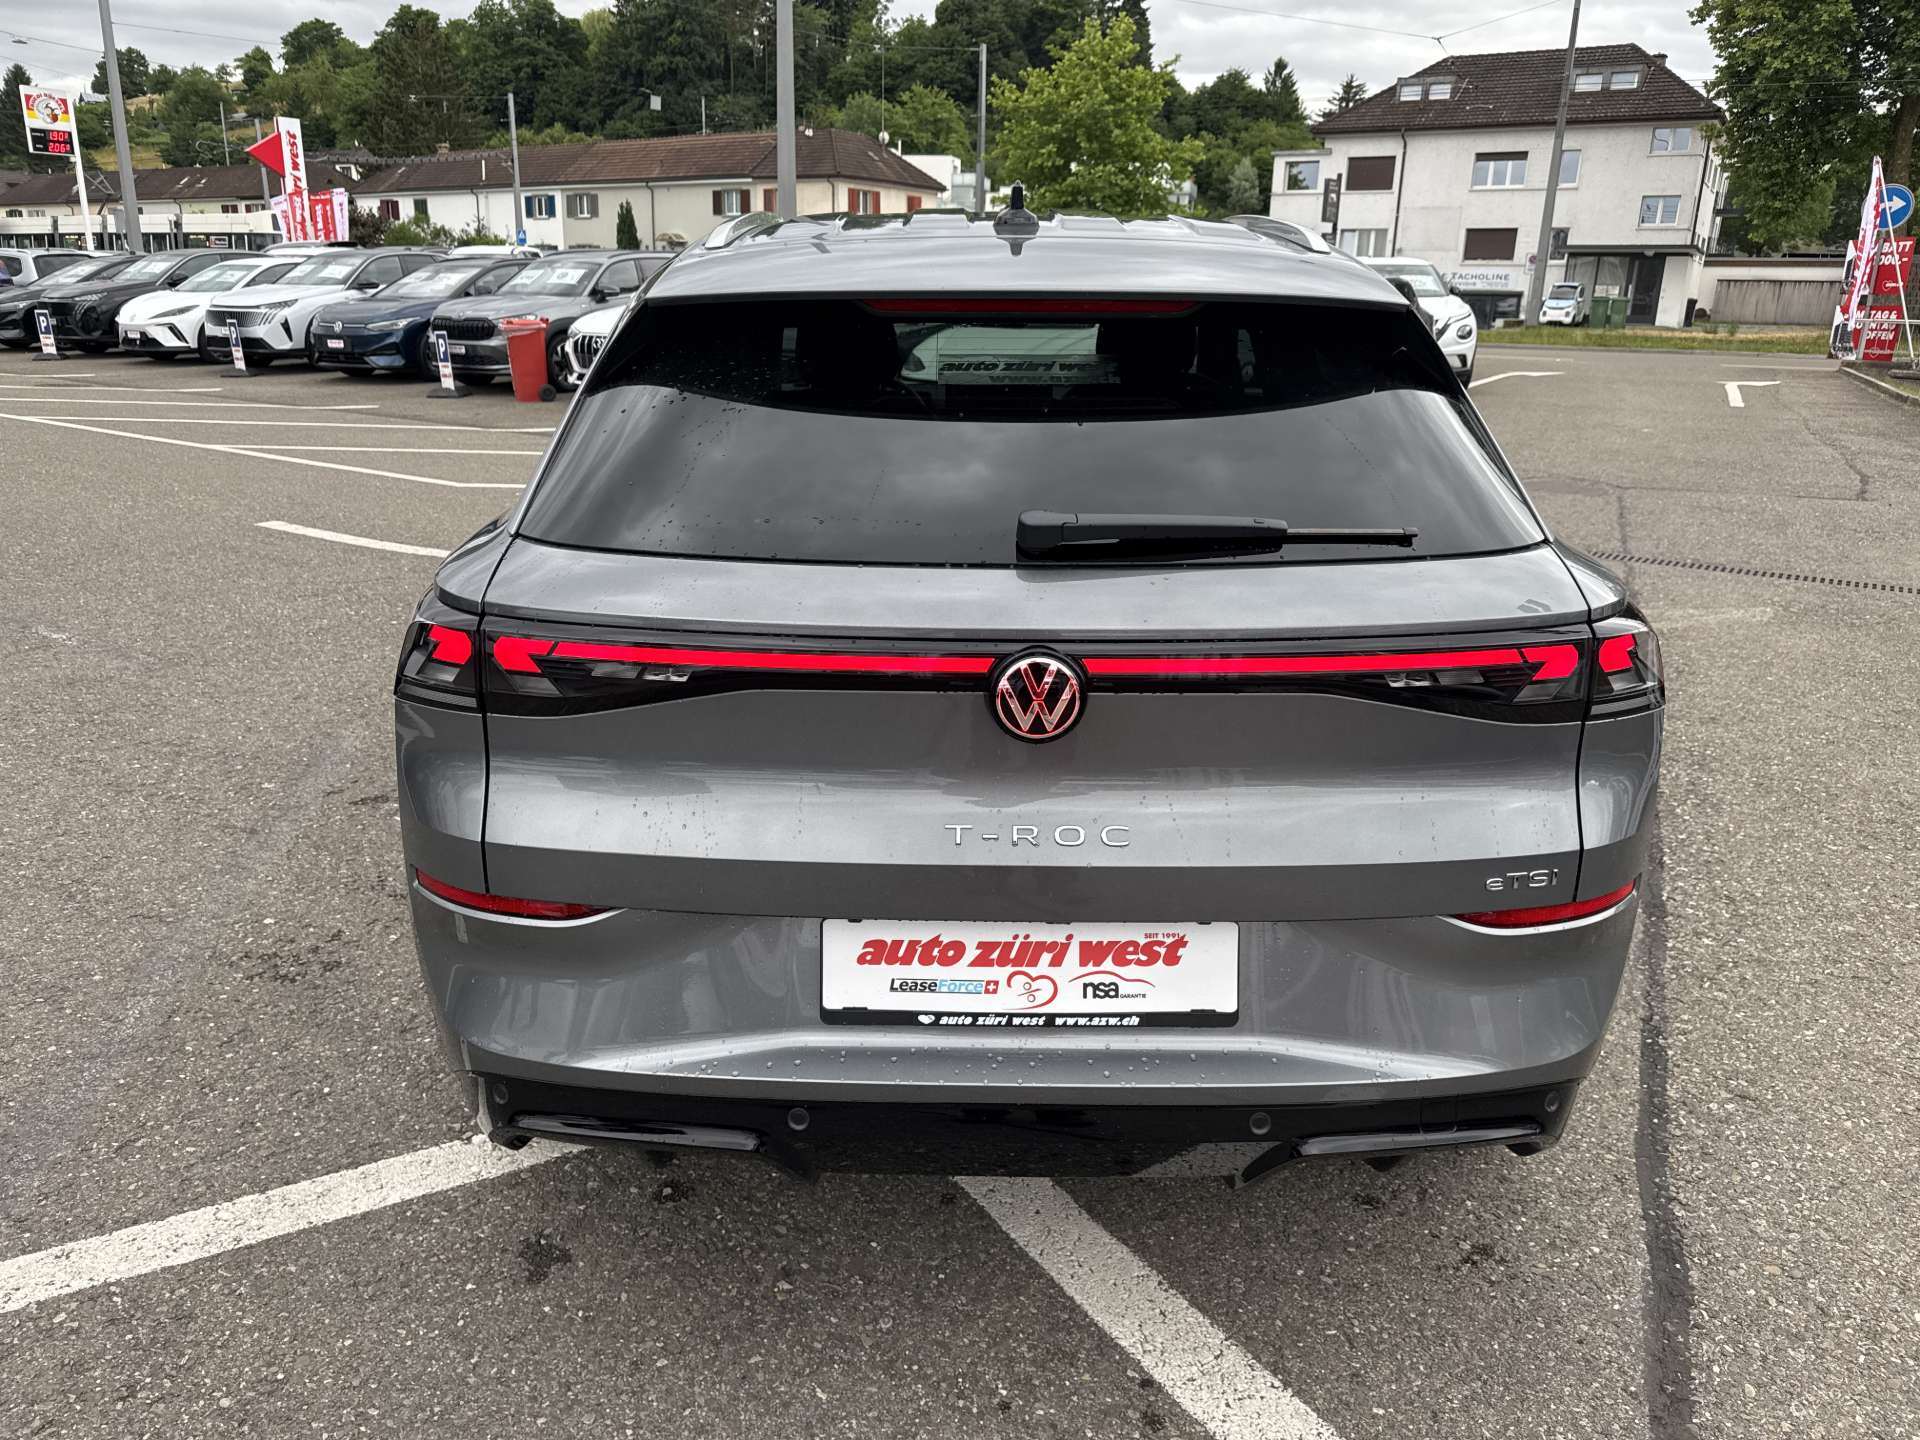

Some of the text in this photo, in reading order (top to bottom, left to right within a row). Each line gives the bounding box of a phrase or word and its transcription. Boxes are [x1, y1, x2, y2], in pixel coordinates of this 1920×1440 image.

[286, 130, 300, 172] west
[1450, 272, 1511, 281] TACHOLINE
[39, 315, 47, 333] P
[438, 338, 446, 359] P
[944, 824, 1131, 848] T-ROC
[856, 933, 1189, 967] auto züri west
[889, 977, 984, 993] LeaseForce
[1082, 981, 1119, 999] nsa
[939, 1013, 1140, 1027] auto züri west www.azw.ch
